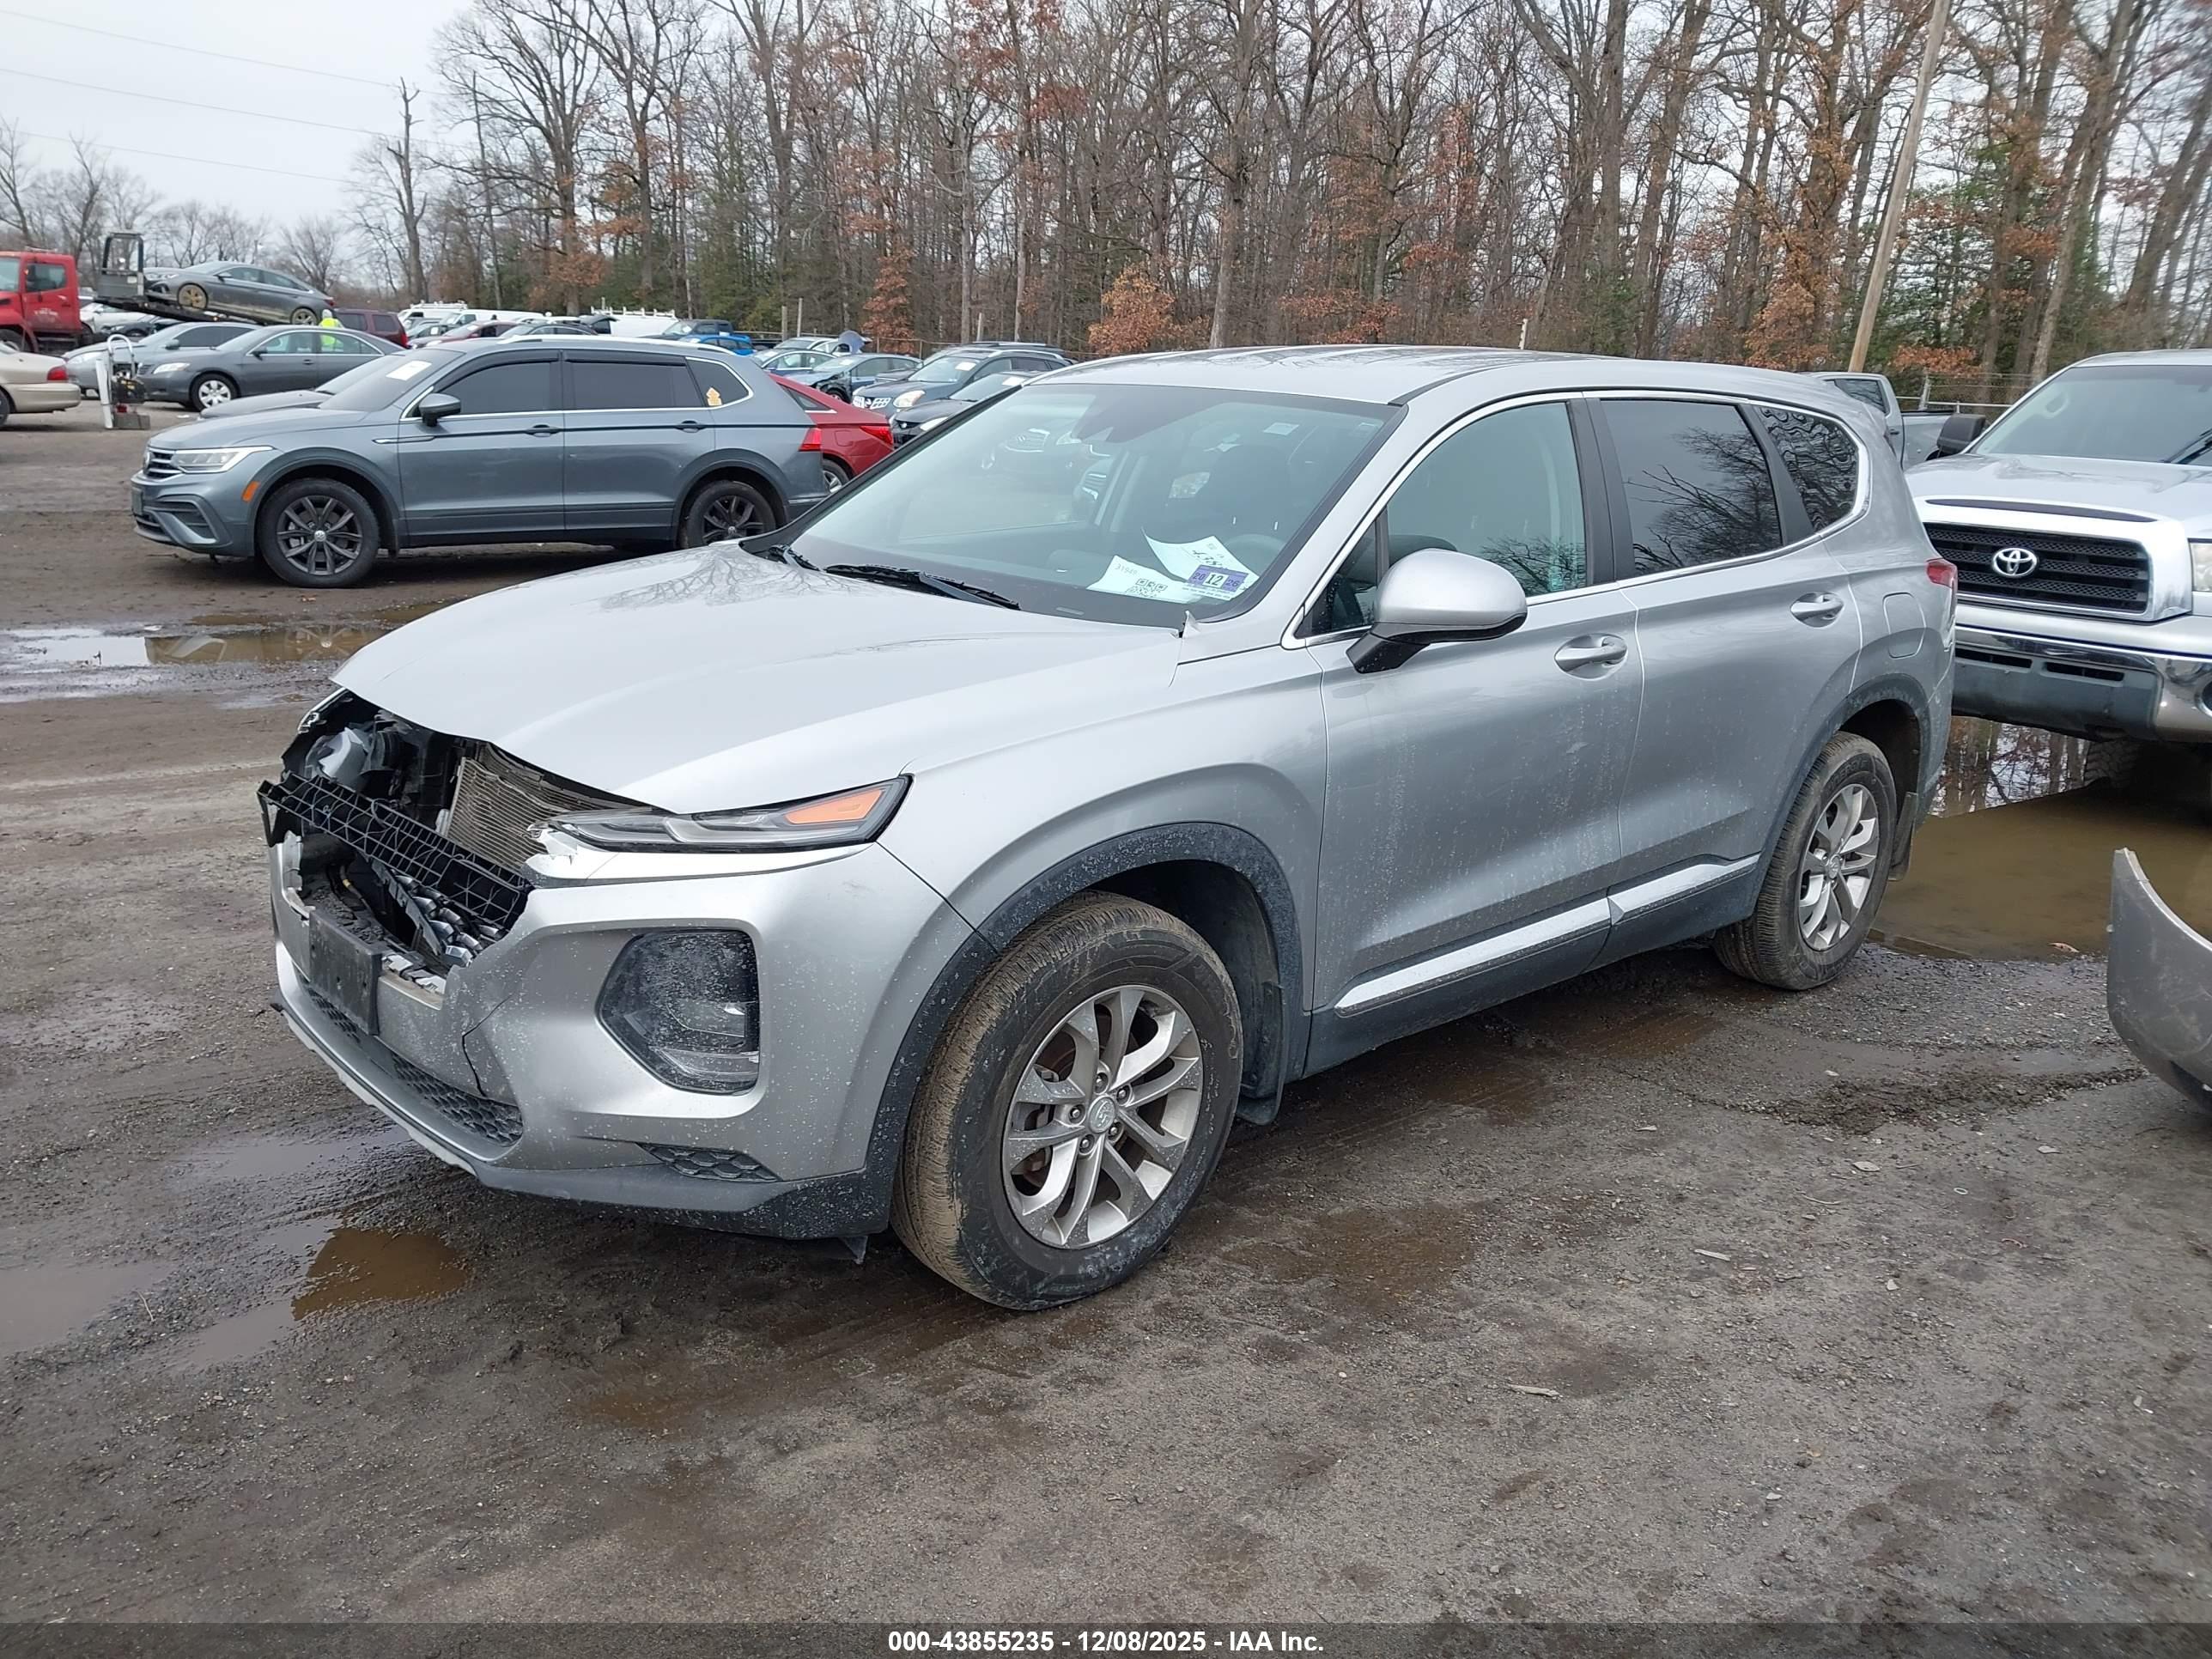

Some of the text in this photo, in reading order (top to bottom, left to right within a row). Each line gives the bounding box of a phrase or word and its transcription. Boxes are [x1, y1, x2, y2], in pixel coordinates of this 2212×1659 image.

[1193, 572, 1206, 581] 20
[1205, 574, 1224, 586] 12
[1225, 579, 1240, 587] 26
